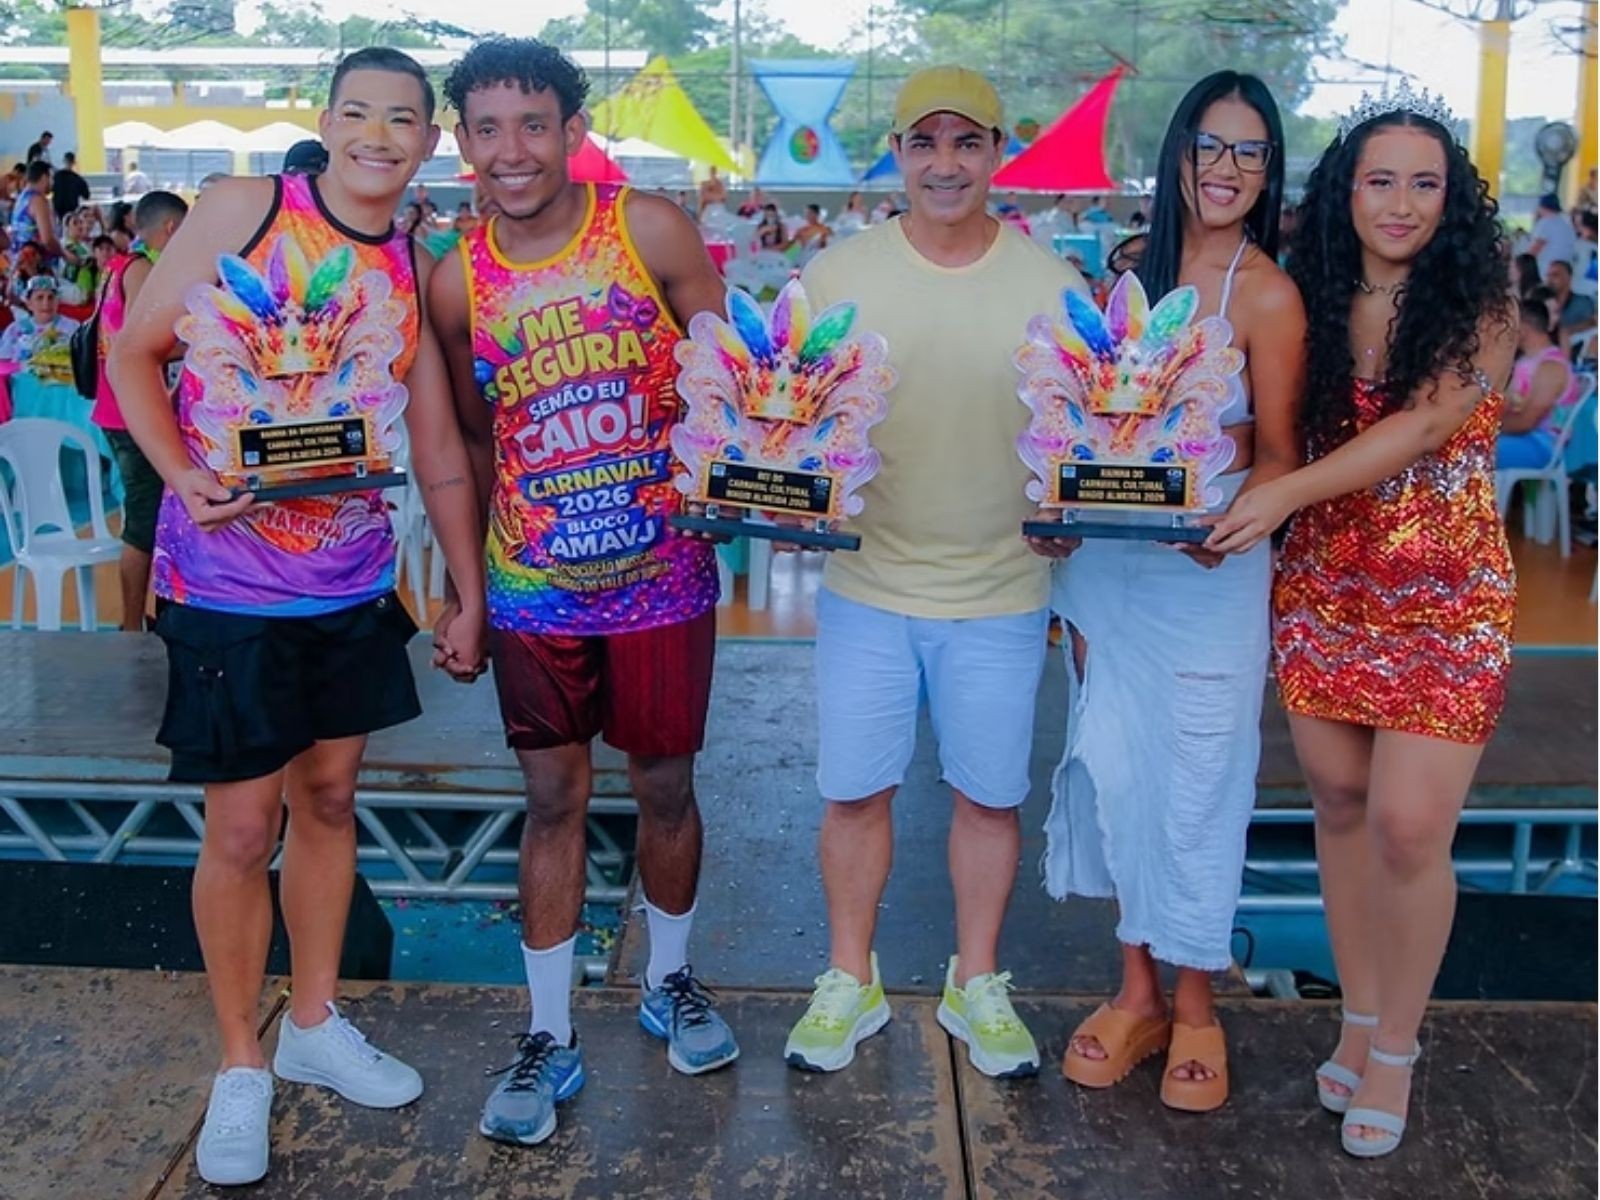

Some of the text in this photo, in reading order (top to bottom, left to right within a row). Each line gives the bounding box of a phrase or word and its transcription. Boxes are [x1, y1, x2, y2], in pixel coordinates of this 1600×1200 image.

[521, 300, 584, 351] ME
[496, 330, 648, 407] SEGURA
[528, 380, 626, 422] SENÃO EU
[514, 394, 645, 464] CAIO!
[528, 457, 657, 499] CARNAVAL
[558, 485, 631, 516] 2026
[550, 520, 656, 559] AMAVJ
[567, 513, 629, 535] BLOCO
